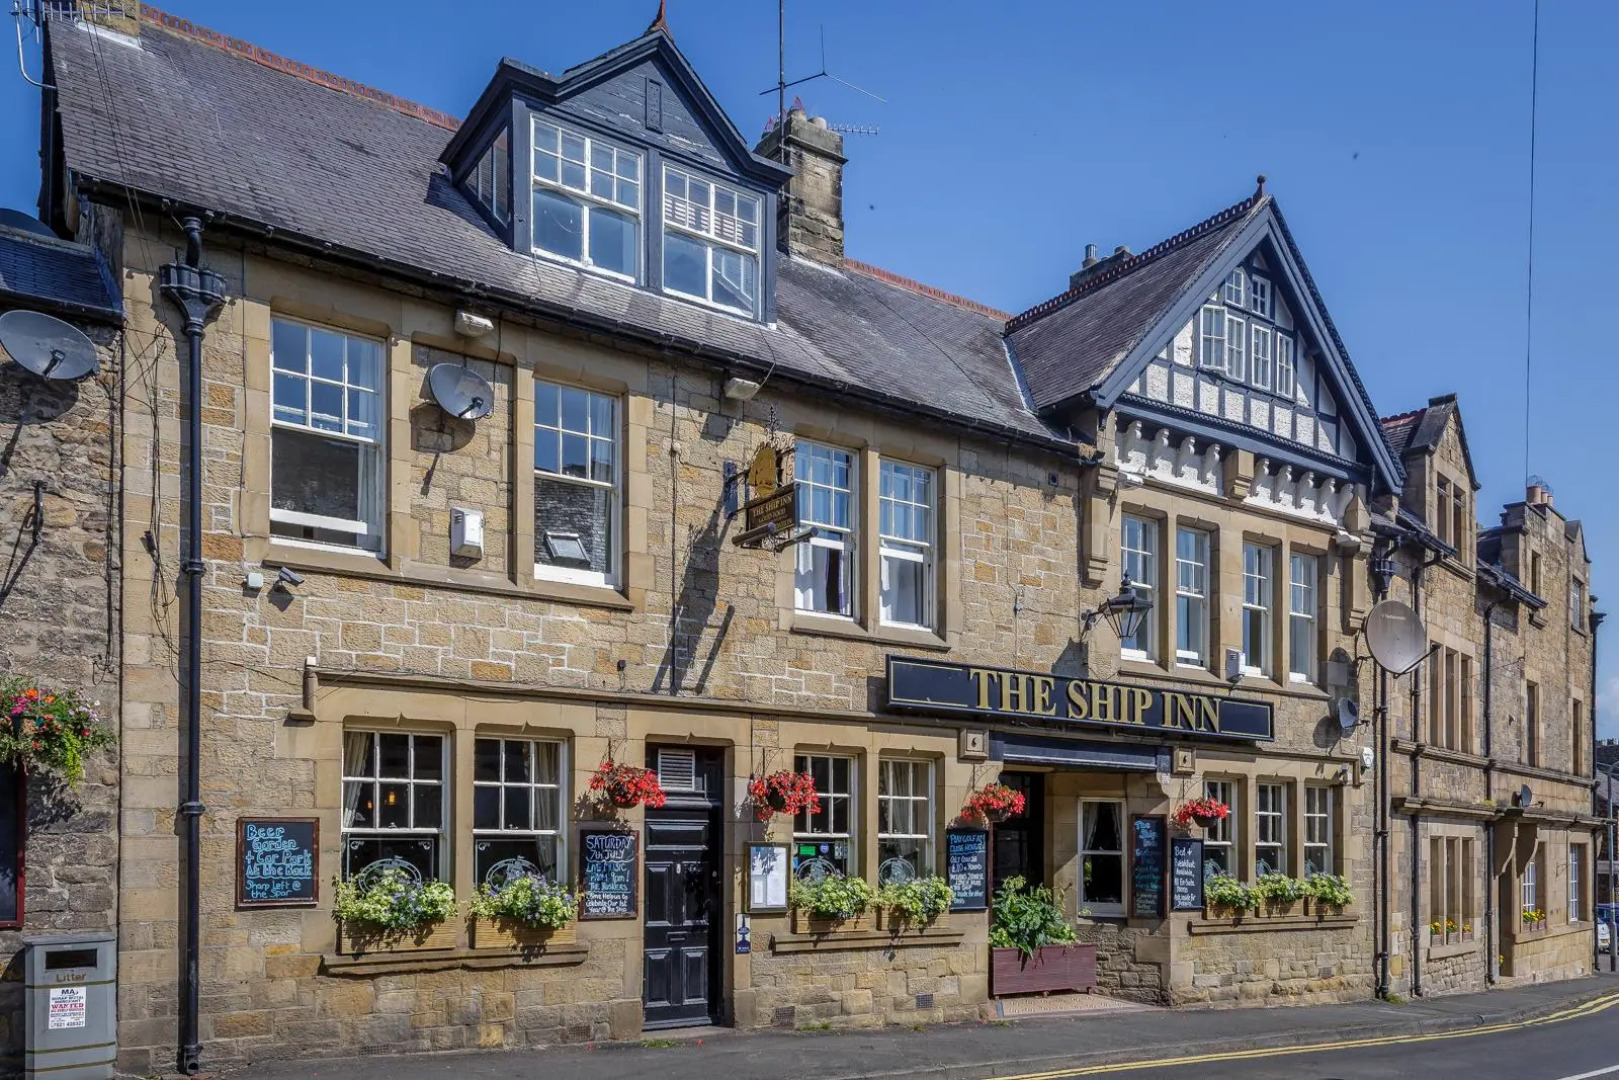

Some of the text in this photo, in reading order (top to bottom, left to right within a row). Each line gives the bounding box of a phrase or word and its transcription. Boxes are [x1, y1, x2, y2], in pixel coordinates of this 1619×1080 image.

[753, 494, 792, 517] THE SHIP INN
[969, 668, 1222, 734] THE SHIP INN
[246, 824, 285, 839] Beer
[586, 837, 632, 849] SATURDAY
[962, 834, 976, 843] GOLF
[252, 838, 297, 851] Garden
[604, 849, 625, 860] JULY
[1174, 846, 1186, 856] Bed
[256, 851, 279, 864] Car
[281, 850, 312, 865] Park
[262, 864, 283, 876] the
[284, 864, 312, 876] Back
[586, 861, 627, 872] LIVE MUSIC
[246, 880, 270, 891] Sharp
[272, 880, 290, 890] Left
[251, 889, 292, 898] the Spar
[56, 973, 86, 982] Litter
